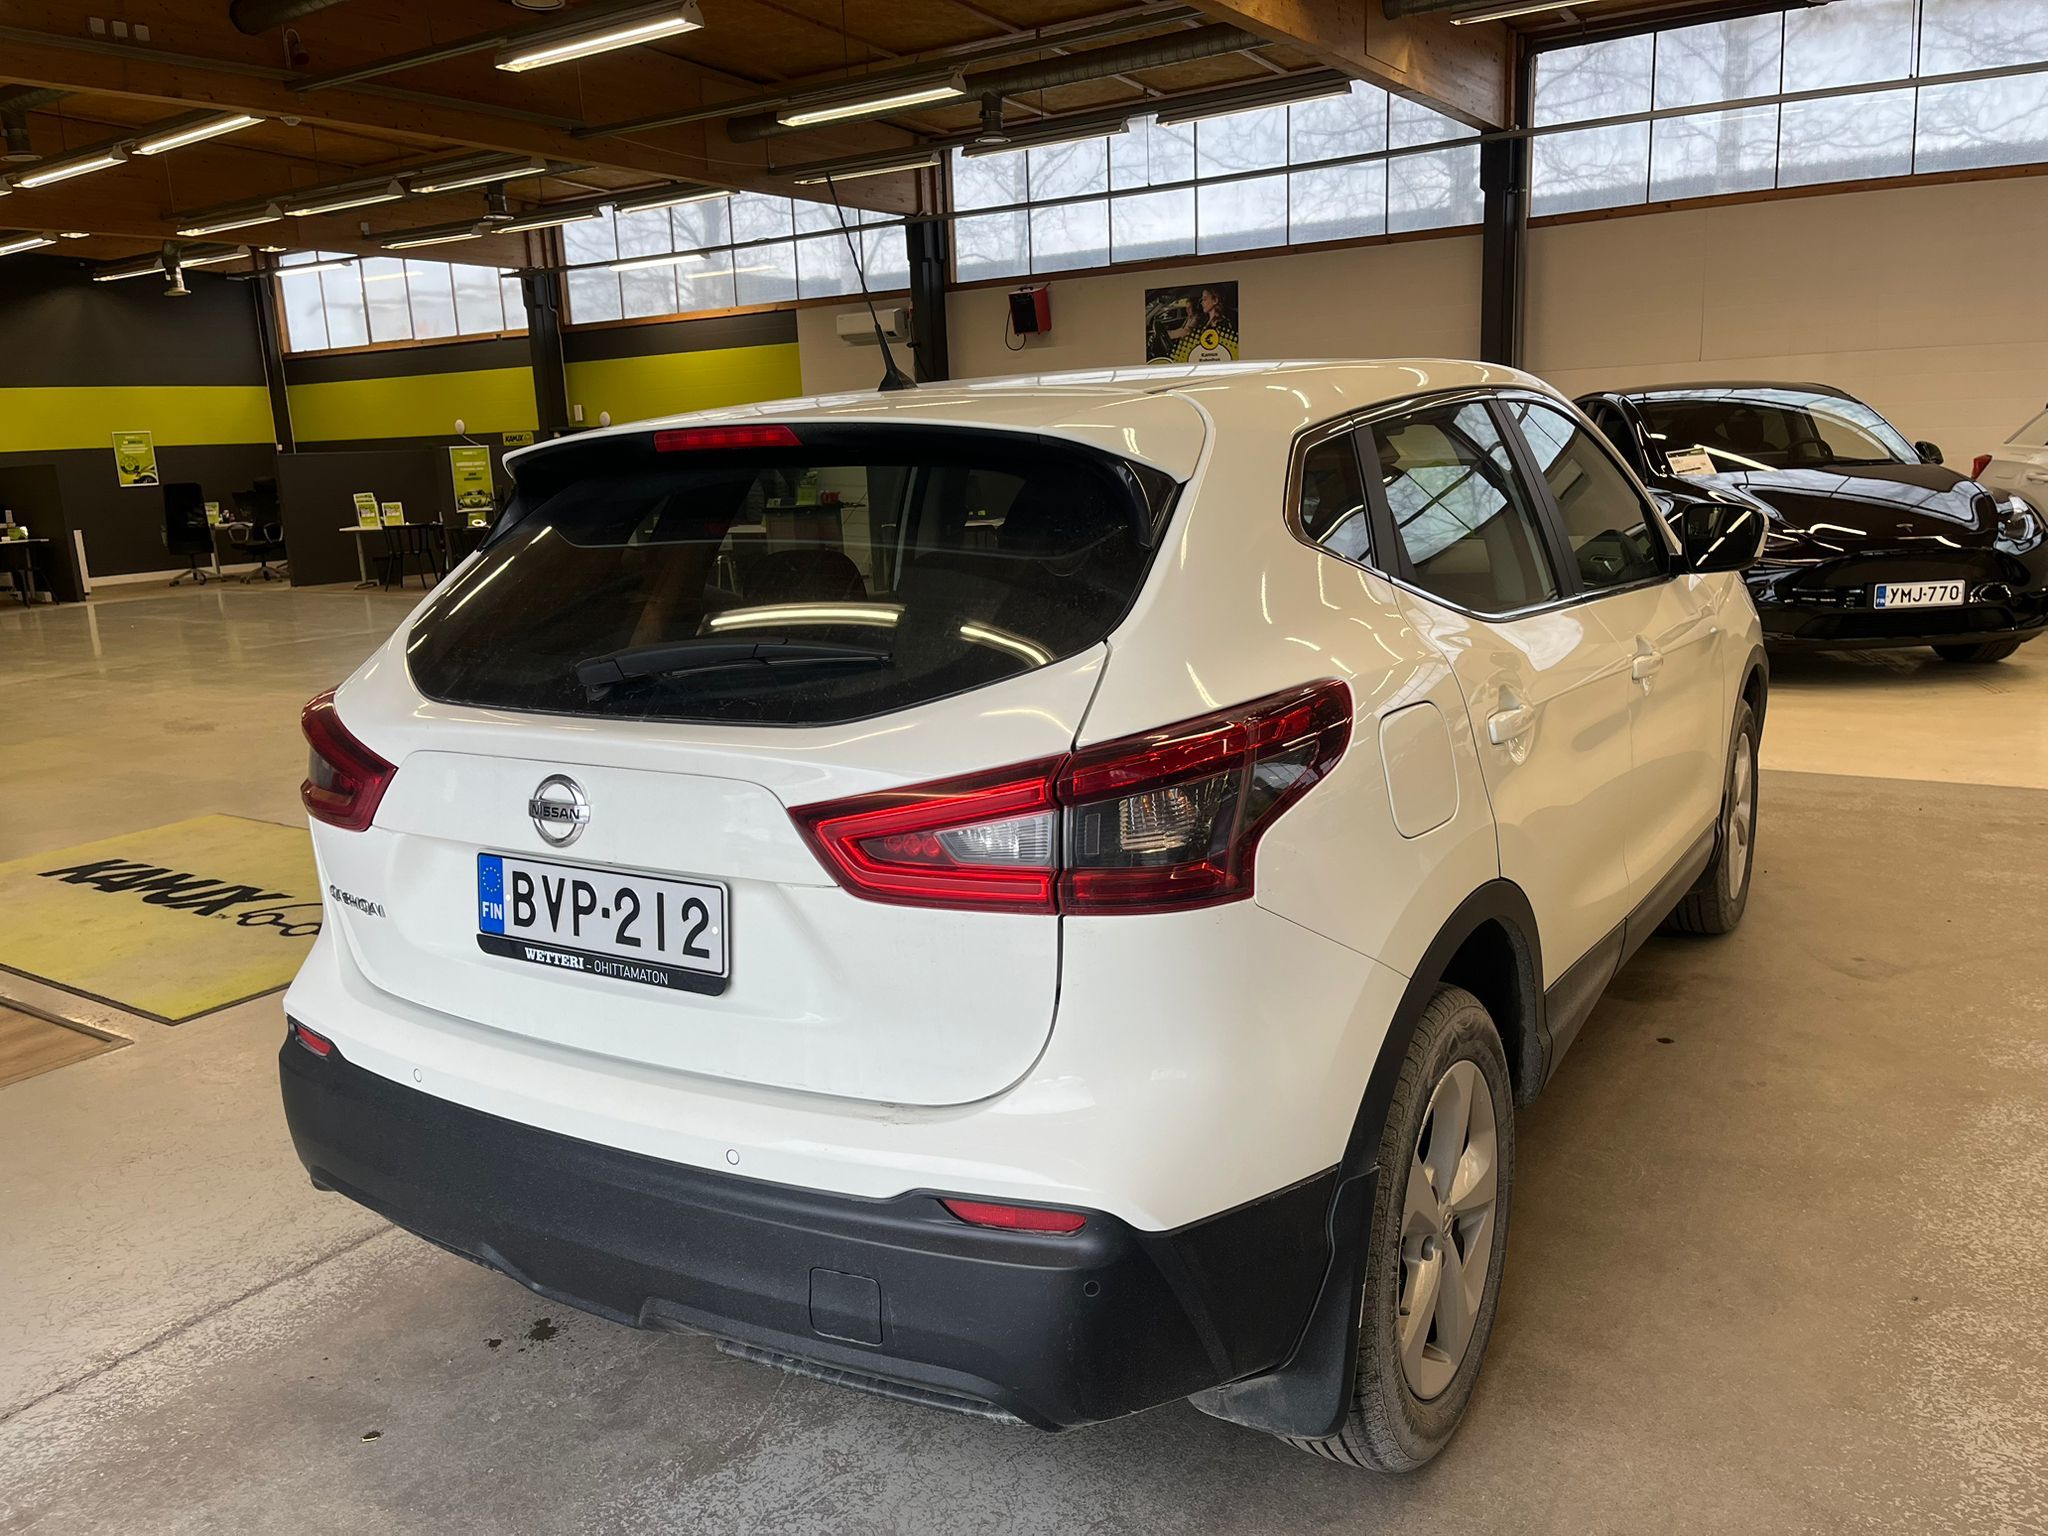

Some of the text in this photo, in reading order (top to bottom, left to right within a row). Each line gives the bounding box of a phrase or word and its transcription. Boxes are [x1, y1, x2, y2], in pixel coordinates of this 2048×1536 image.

[1889, 585, 1960, 604] YMJ-770
[531, 803, 580, 820] NISSAN
[36, 859, 295, 916] KAMUX
[482, 900, 503, 921] FIN
[511, 870, 710, 959] BVP-212
[524, 946, 585, 970] WETTERI
[594, 959, 669, 985] OHITTAMATON
